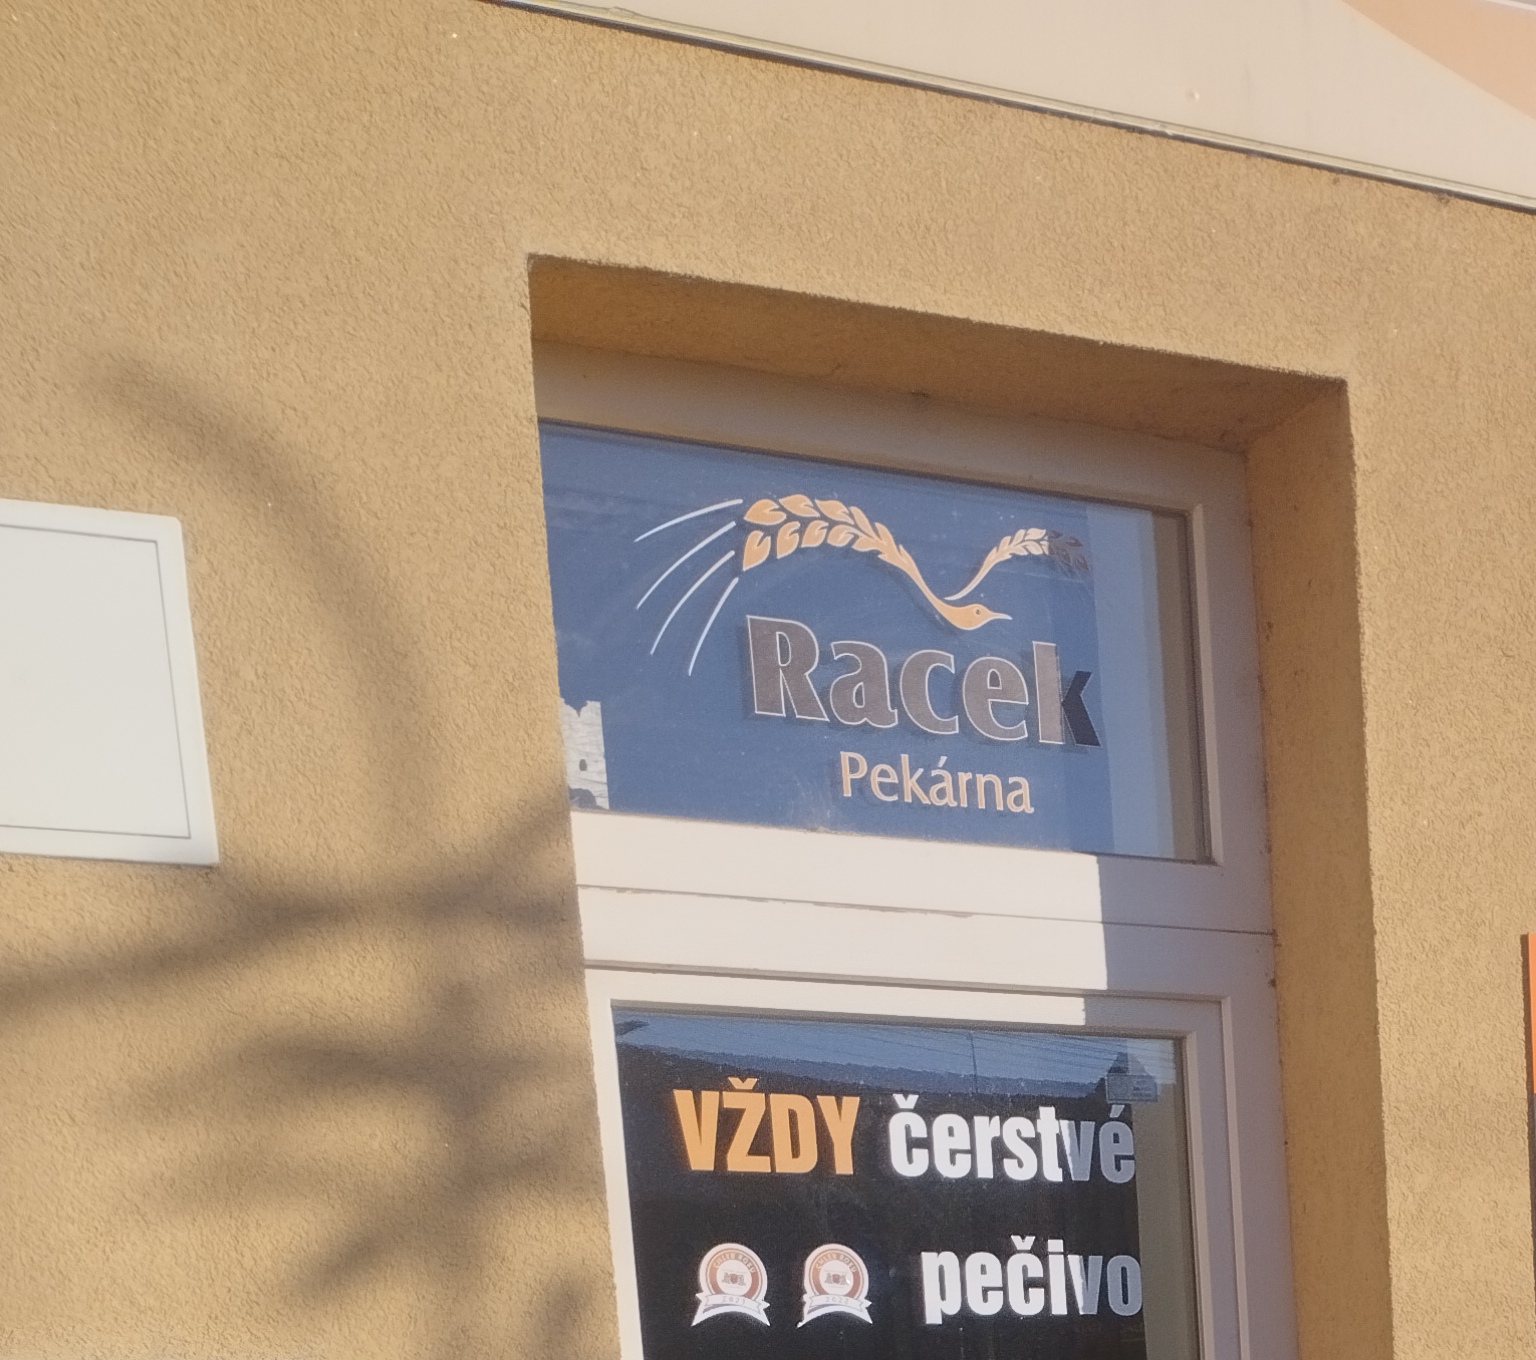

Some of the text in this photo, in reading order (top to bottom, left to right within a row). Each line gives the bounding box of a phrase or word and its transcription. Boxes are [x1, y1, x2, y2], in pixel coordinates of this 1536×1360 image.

[745, 614, 1101, 748] Racek
[839, 751, 1034, 814] Pekárna
[673, 1077, 1136, 1184] VŽDY čerstvé
[920, 1235, 1143, 1325] pečivo
